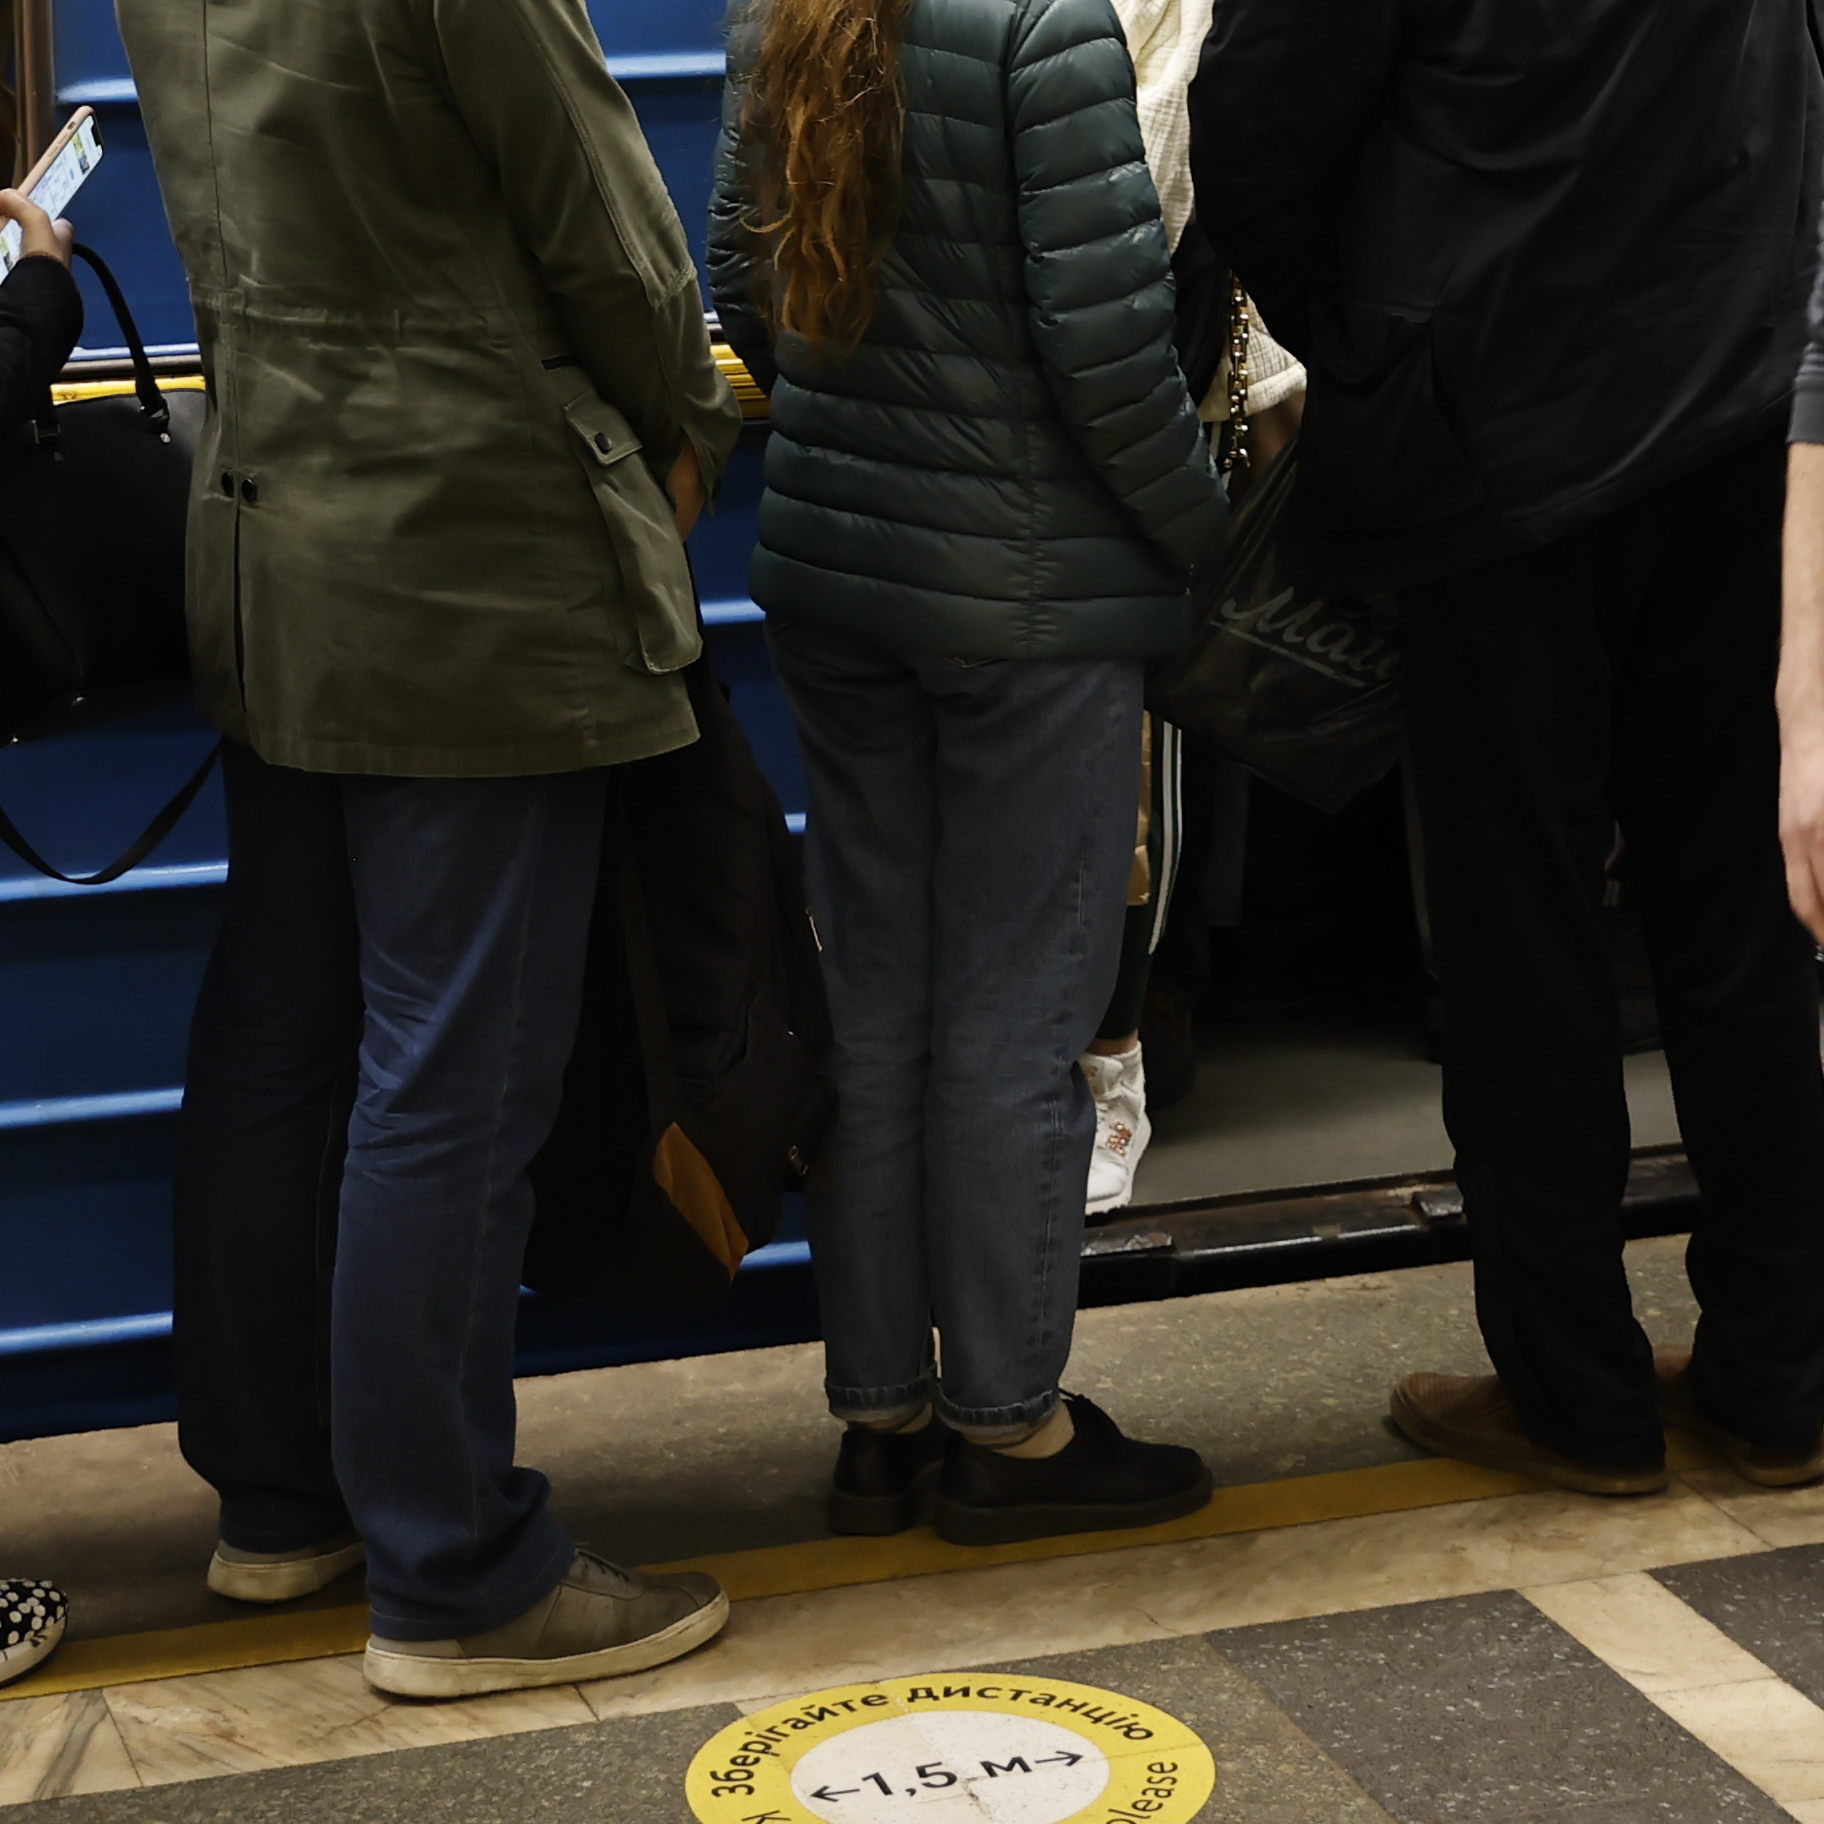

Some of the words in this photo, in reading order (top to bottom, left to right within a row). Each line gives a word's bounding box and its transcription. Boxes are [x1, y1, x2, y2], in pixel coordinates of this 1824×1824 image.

[709, 1693, 890, 1797] Зберігайте
[907, 1685, 1154, 1740] дистанцію
[861, 1761, 958, 1797] 1,5
